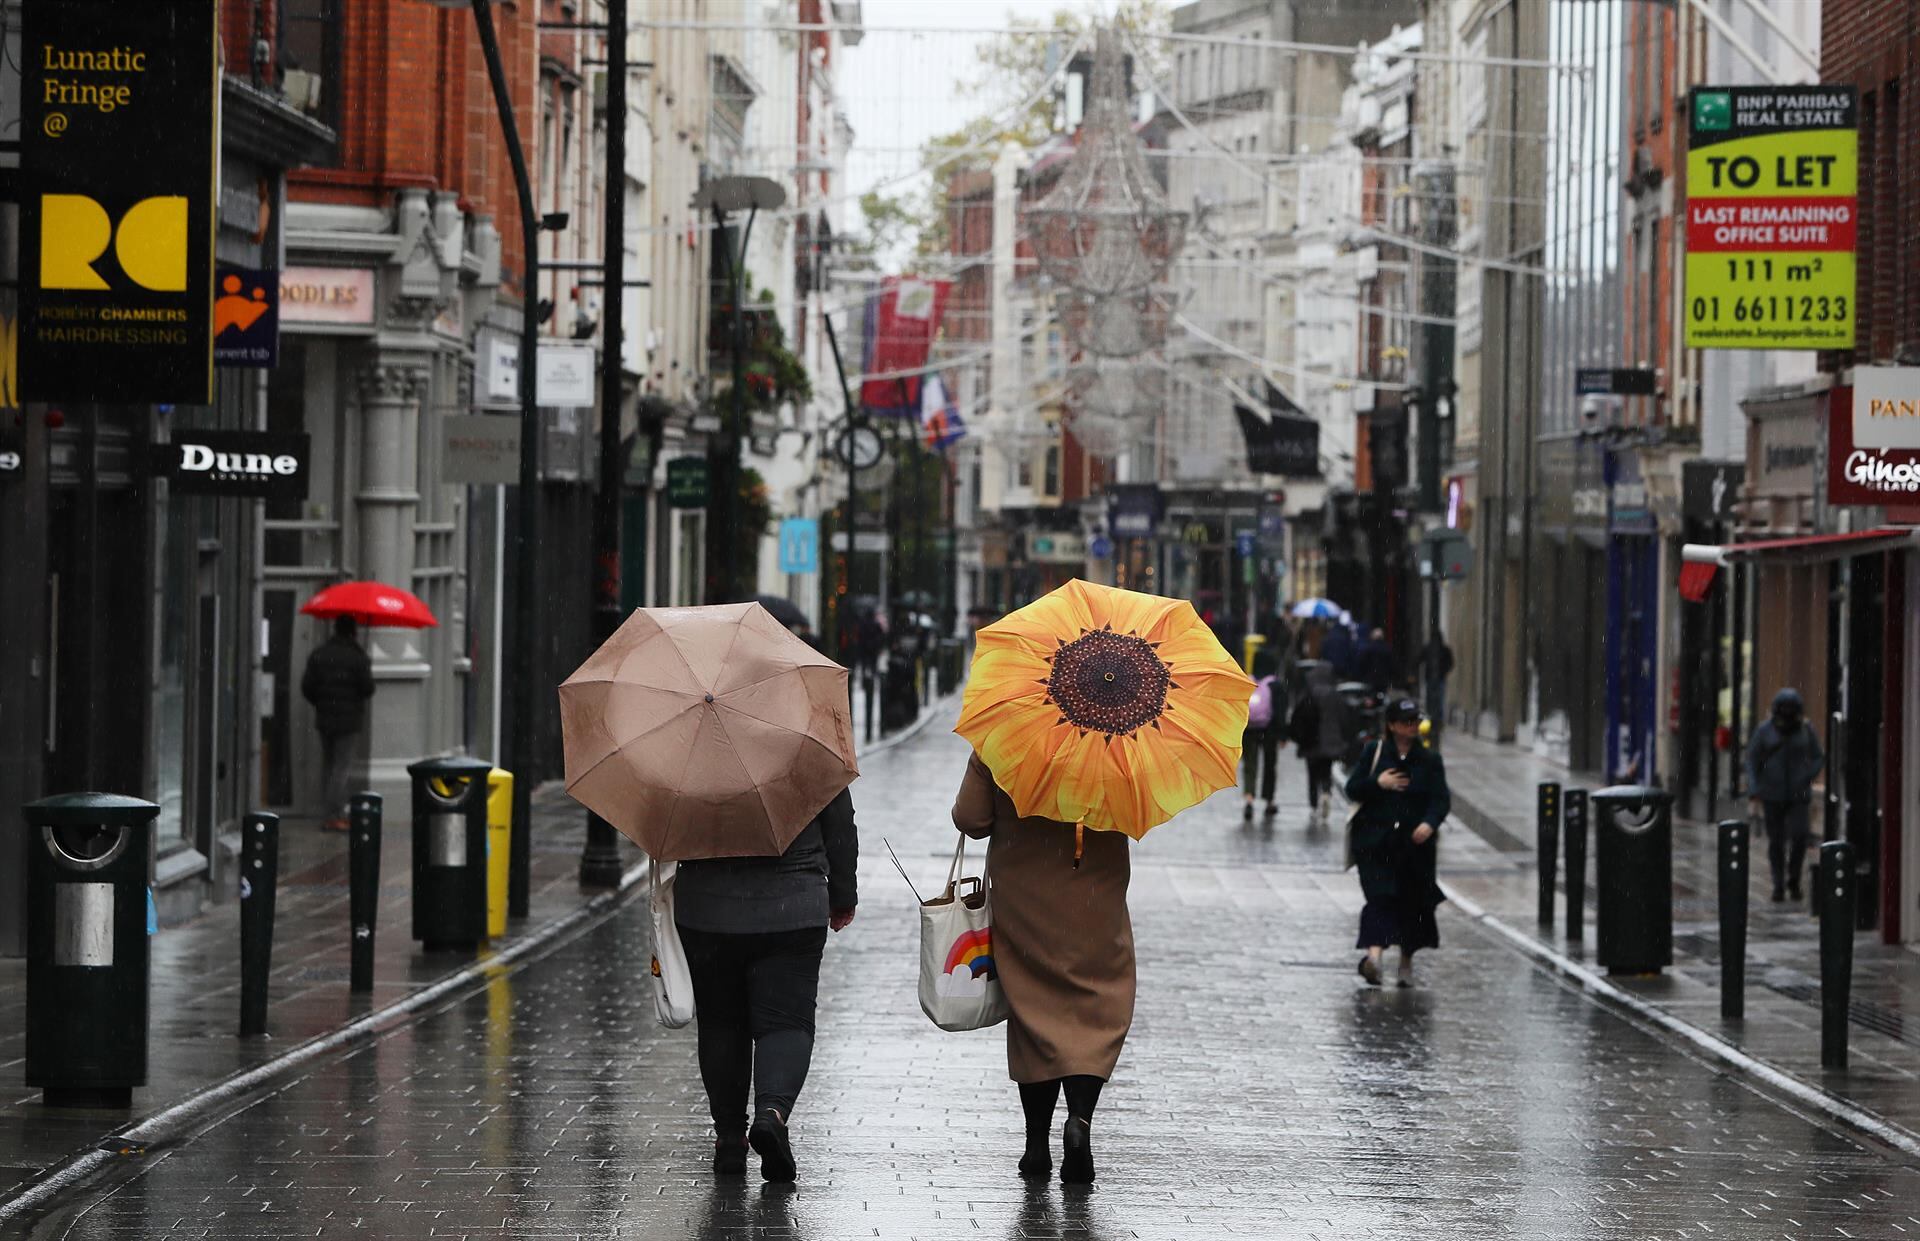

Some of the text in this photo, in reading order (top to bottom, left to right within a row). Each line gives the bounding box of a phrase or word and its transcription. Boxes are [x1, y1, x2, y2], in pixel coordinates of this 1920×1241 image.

[44, 45, 146, 72] Lunatic
[44, 79, 131, 112] Fringe
[1737, 94, 1850, 110] BNP PARIBAS
[44, 112, 68, 137] @
[1737, 110, 1844, 126] REAL ESTATE
[1707, 155, 1837, 188] TO LET
[1694, 206, 1850, 224] LAST REMAINING
[1714, 226, 1829, 243] OFFICE SUITE
[1728, 259, 1773, 281] 111
[40, 307, 188, 322] ROBERT CHAMBERS
[1692, 296, 1847, 321] 01 6611233
[38, 327, 188, 345] HAIRDRESSING
[1869, 399, 1920, 417] PAN
[179, 444, 298, 474] Dune
